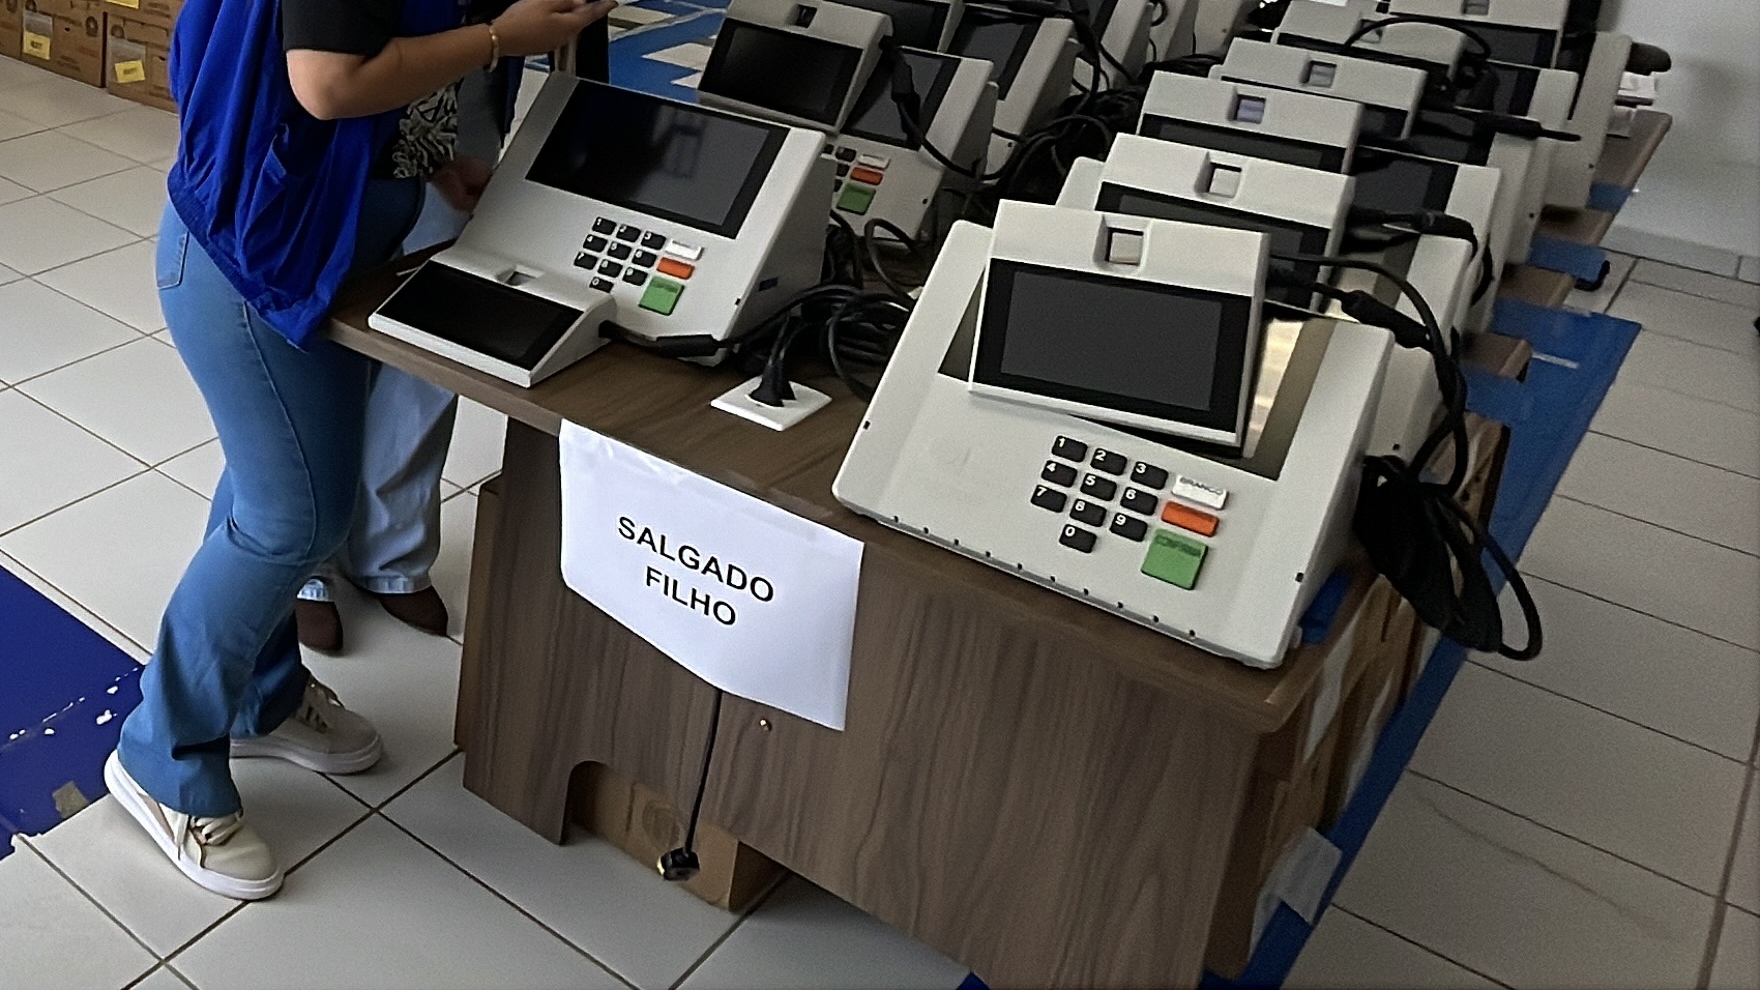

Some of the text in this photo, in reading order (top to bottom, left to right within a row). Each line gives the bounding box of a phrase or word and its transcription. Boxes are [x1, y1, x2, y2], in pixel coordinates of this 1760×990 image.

[1059, 437, 1066, 448] 1
[1095, 450, 1107, 462] 2
[1135, 463, 1147, 474] 3
[1046, 462, 1137, 500] 4 5 6
[1036, 486, 1047, 497] 7
[1075, 500, 1086, 512] 8
[1115, 514, 1127, 526] 9
[1065, 526, 1076, 537] 0
[618, 515, 774, 603] SALGADO
[645, 565, 737, 626] FILHO
